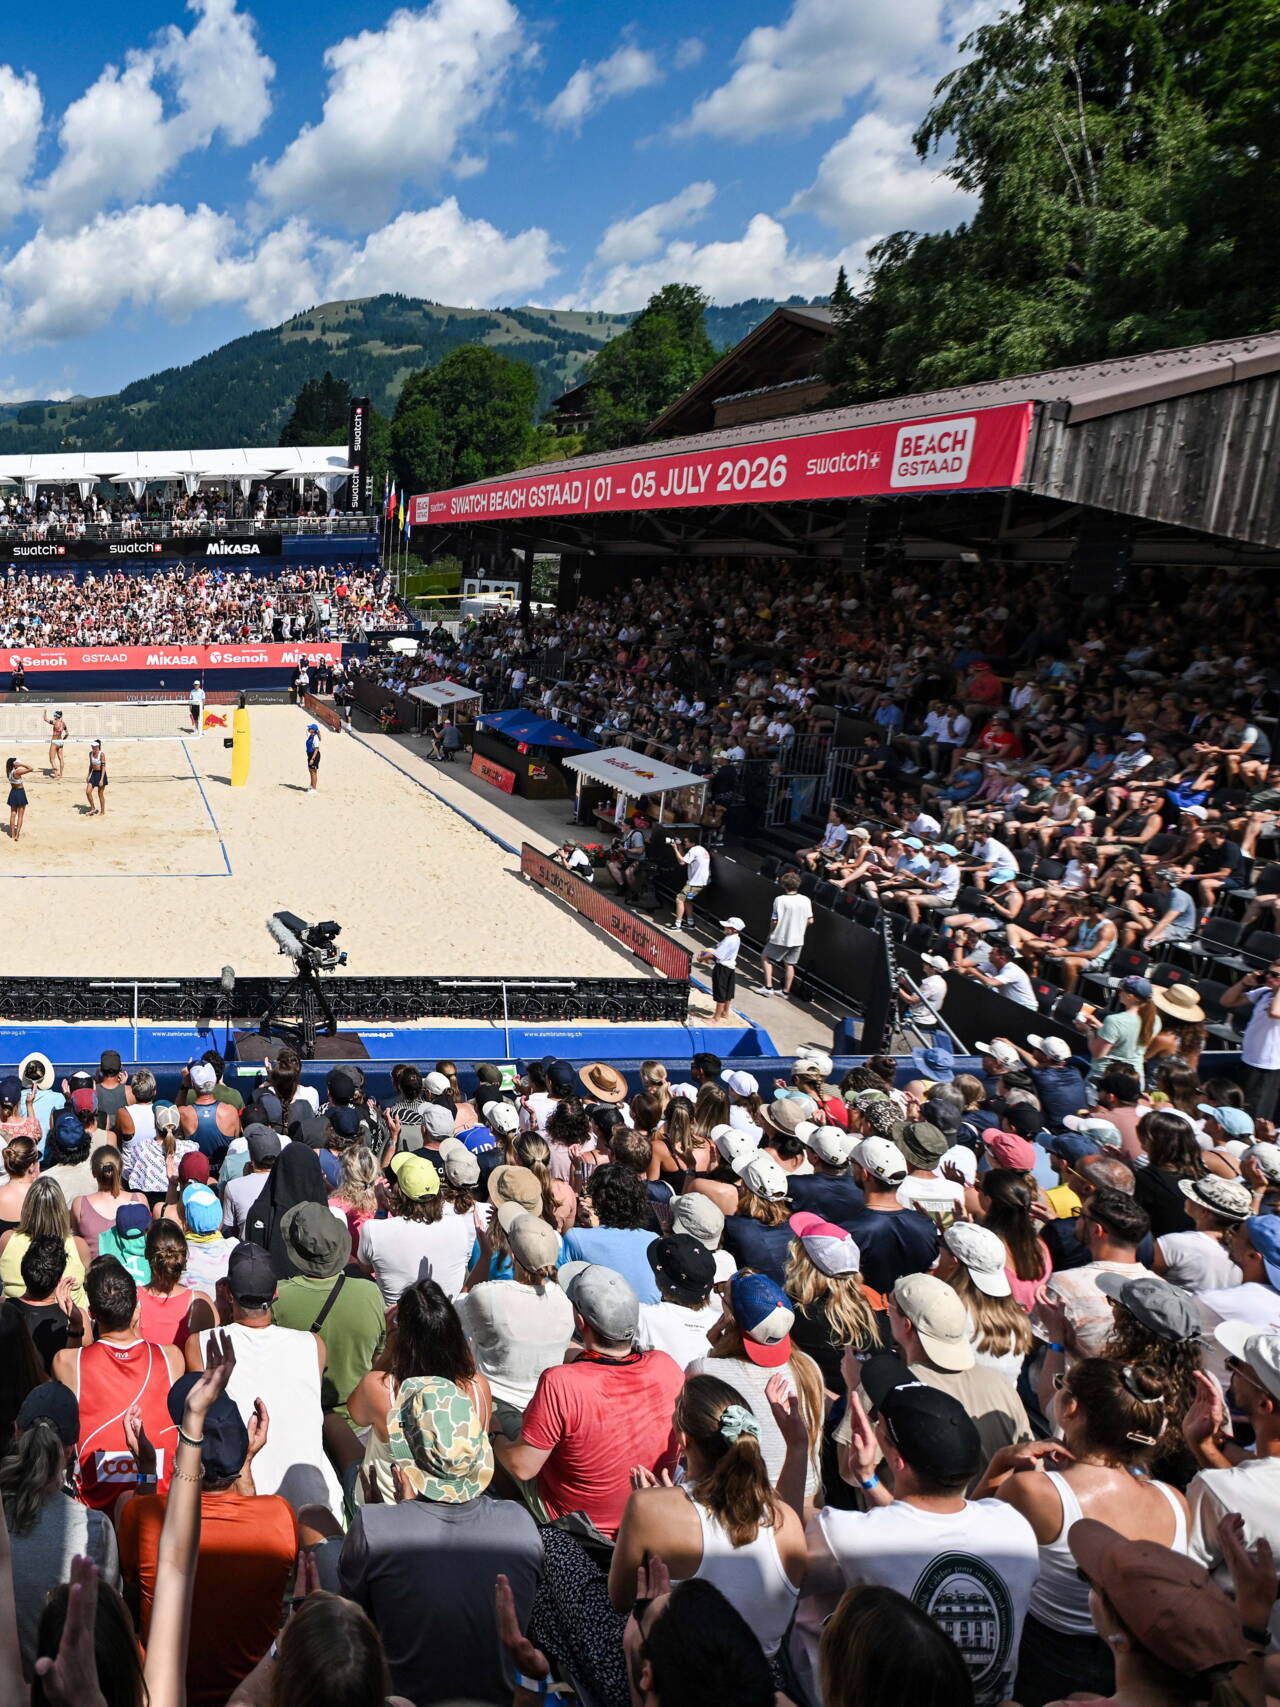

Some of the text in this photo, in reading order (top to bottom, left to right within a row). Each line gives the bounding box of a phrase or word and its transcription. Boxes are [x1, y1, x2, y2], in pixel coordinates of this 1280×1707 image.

[354, 414, 362, 451] swatch
[900, 429, 967, 458] BEACH
[806, 449, 869, 476] swatch
[898, 457, 962, 477] GSTAAD
[352, 471, 360, 508] swatch
[451, 493, 488, 515] SWATCH
[489, 488, 526, 511] BEACH
[528, 481, 582, 508] GSTAAD
[594, 476, 612, 502] 01
[631, 471, 656, 499] 05
[660, 464, 712, 497] JULY
[716, 454, 787, 492] 2026
[13, 545, 58, 556] swatch
[109, 543, 154, 554] swatch
[22, 656, 68, 667] Senoh
[82, 654, 128, 663] GSTAAD
[223, 653, 268, 663] Senoh
